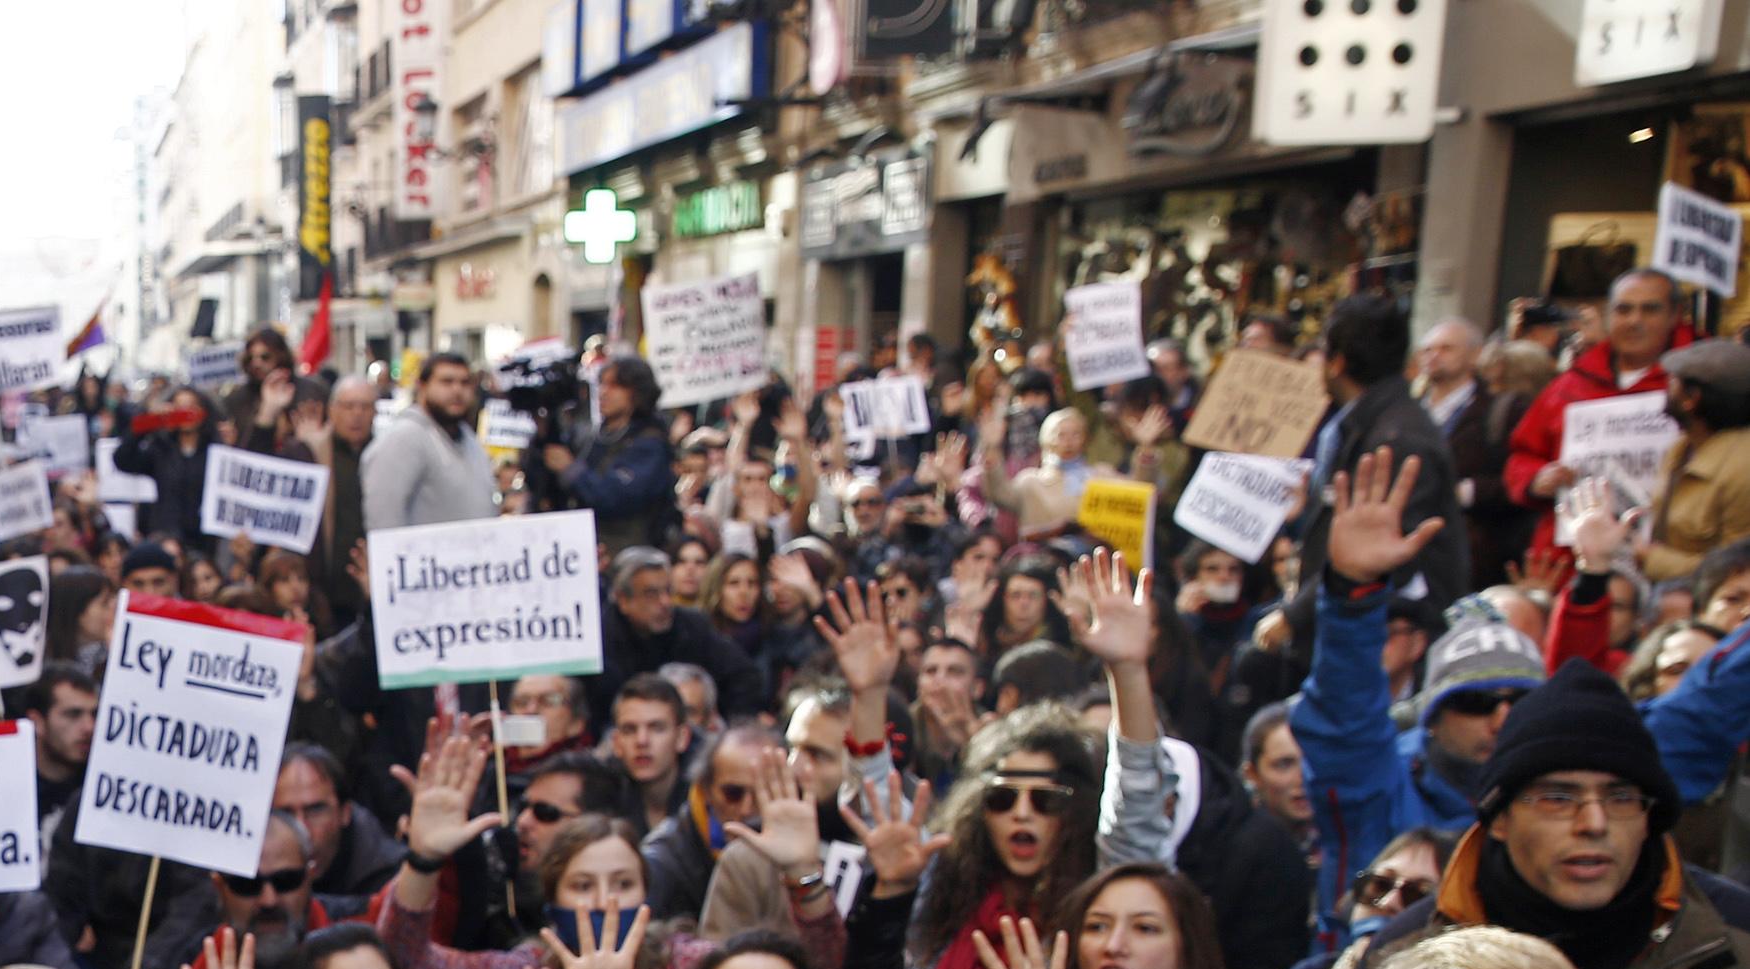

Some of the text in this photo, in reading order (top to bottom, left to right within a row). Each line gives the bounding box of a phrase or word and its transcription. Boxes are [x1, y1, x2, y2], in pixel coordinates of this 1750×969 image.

[1596, 12, 1684, 56] SIX
[1294, 91, 1408, 120] SIX
[388, 541, 580, 604] ¡Libertad de
[119, 623, 283, 697] Ley mordaza,
[394, 603, 583, 660] expresión!
[105, 702, 260, 772] DICTADURA
[95, 774, 254, 838] DESCARADA.
